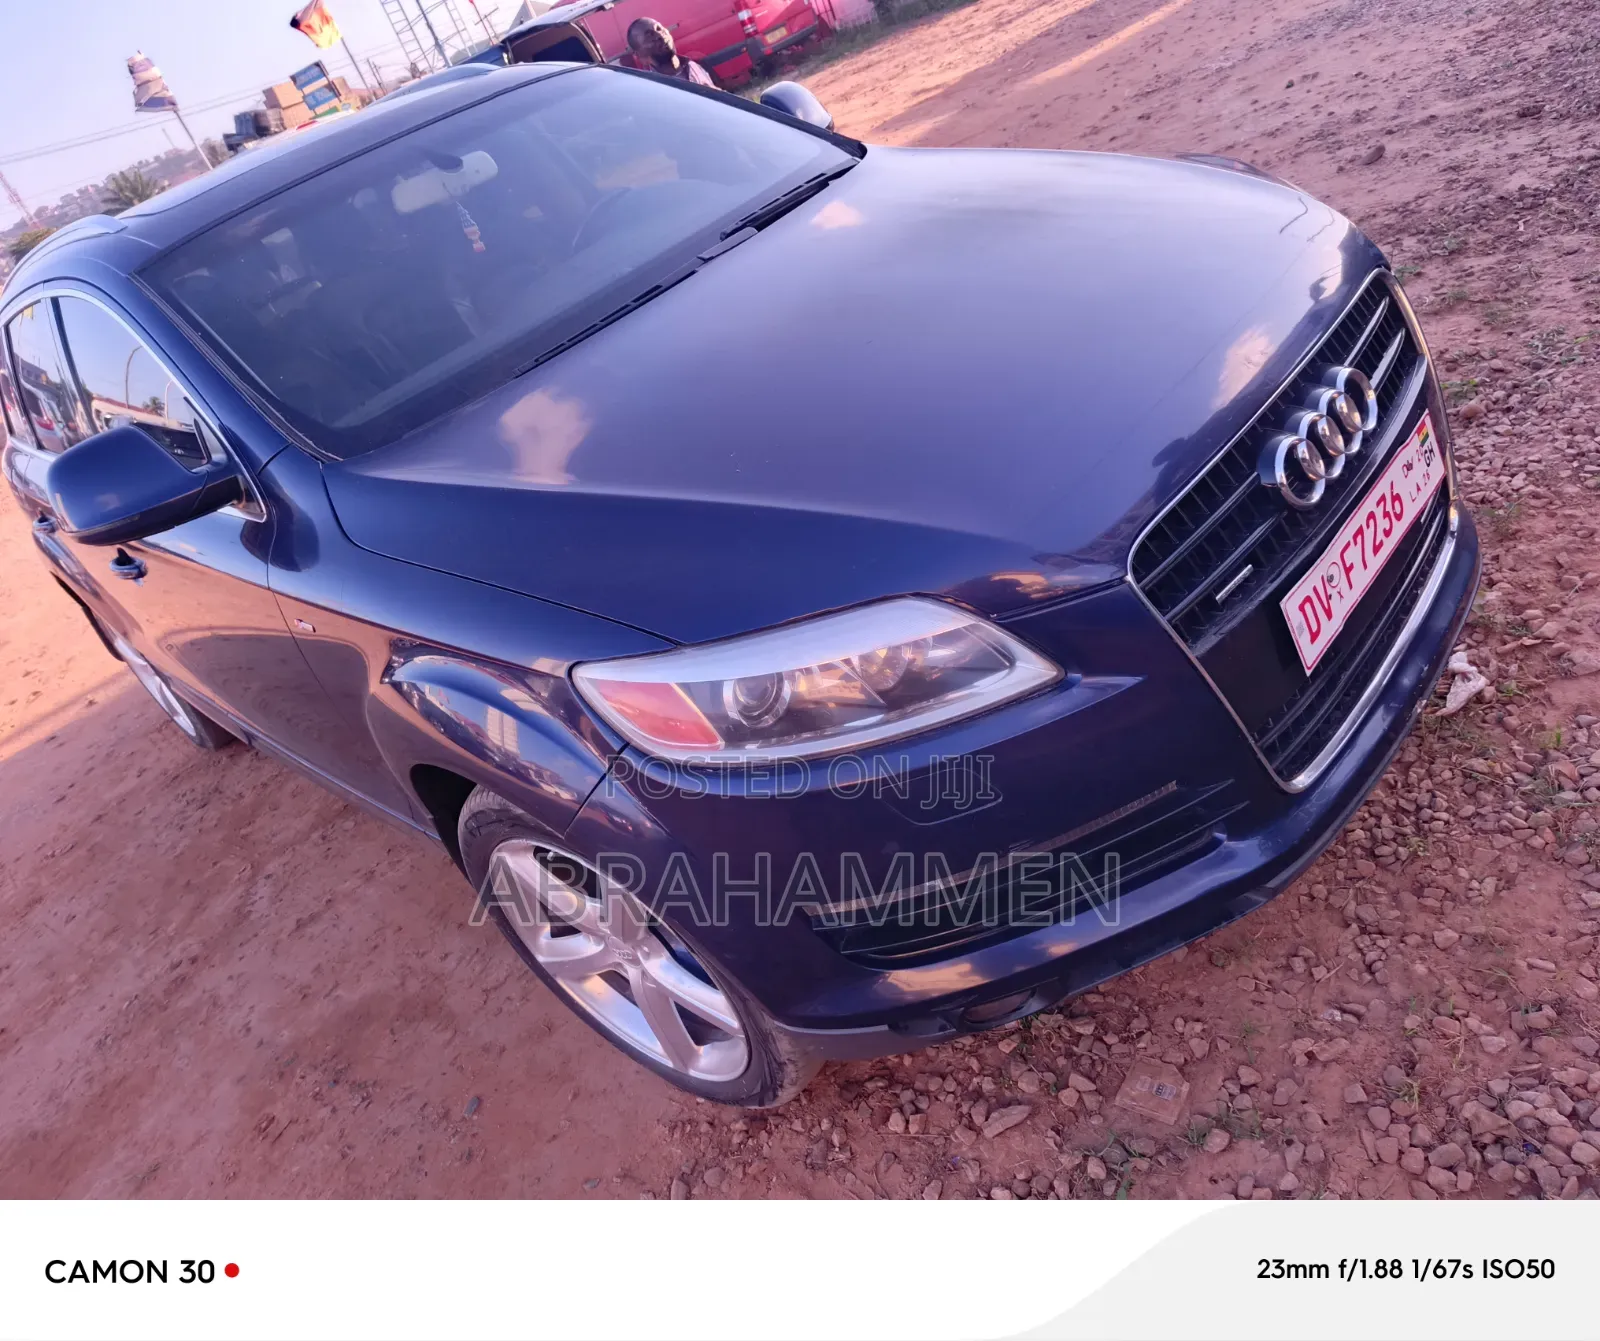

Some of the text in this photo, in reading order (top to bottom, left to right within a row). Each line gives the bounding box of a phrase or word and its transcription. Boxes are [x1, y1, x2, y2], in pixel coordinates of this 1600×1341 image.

[1424, 441, 1436, 467] GH
[1298, 481, 1404, 645] DV F7236
